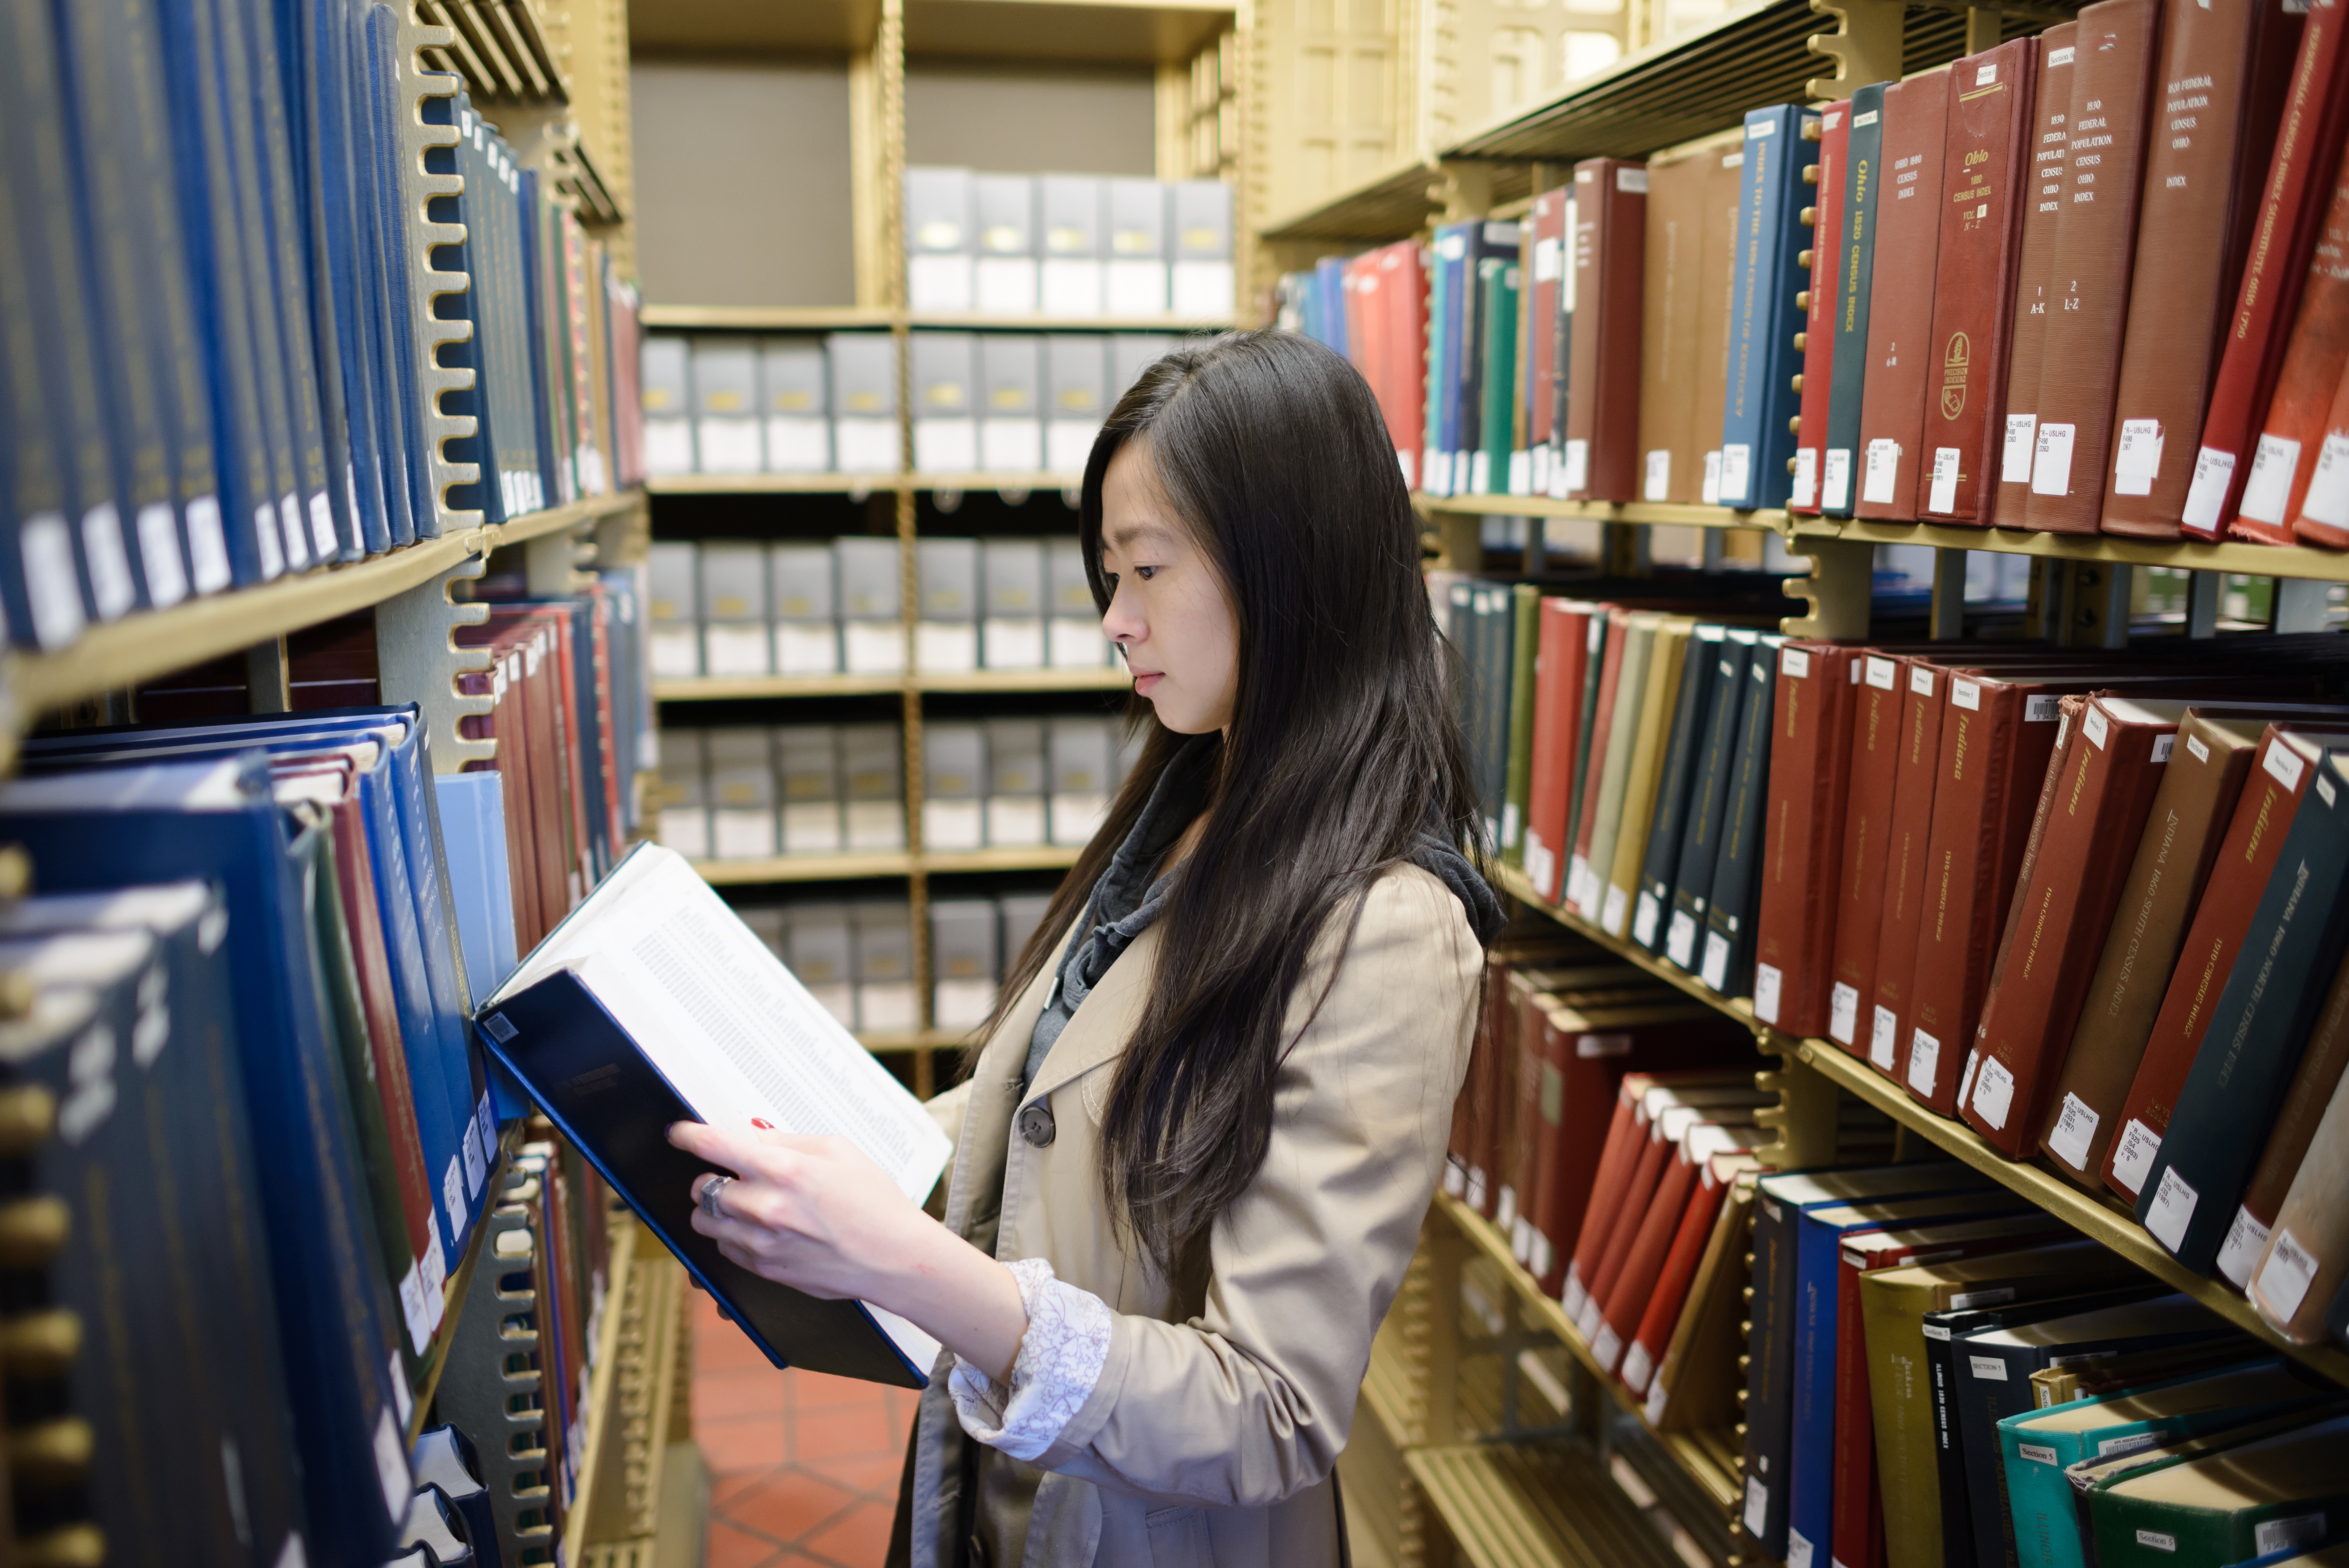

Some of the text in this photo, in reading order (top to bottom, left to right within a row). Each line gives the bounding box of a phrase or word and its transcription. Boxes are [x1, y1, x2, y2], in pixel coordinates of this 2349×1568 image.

[2050, 54, 2068, 64] Section
[2168, 75, 2212, 94] 1820 FEDERAL
[2087, 100, 2100, 111] 1830
[2167, 96, 2208, 112] POPULATION
[2051, 114, 2064, 124] 1830
[2078, 117, 2106, 131] FEDERAL
[2171, 117, 2196, 130] CENSUS
[2071, 135, 2111, 150] POPULATION
[2172, 137, 2190, 149] OHIO
[1894, 157, 1908, 170] OHIO
[1965, 149, 1988, 166] Ohio
[2076, 155, 2100, 166] CENSUS
[1897, 170, 1917, 184] CENSUS
[1971, 174, 1983, 185] 1880
[2078, 174, 2094, 184] OHIO
[2166, 176, 2186, 187] INDEX
[1898, 186, 1914, 200] INDEX
[1953, 186, 1991, 202] CENSUS INDEX
[2043, 184, 2058, 194] OHIO
[2074, 192, 2093, 202] INDEX
[2040, 202, 2058, 212] INDEX
[2237, 110, 2300, 339] CENSUS INDEX SUBSTITUTE OHIO 1790
[1846, 159, 1868, 332] Ohio 1820 CENSUS INDEX
[2038, 287, 2041, 296] 1
[2071, 281, 2076, 291] 2
[2031, 303, 2045, 314] A-K
[2064, 298, 2079, 309] L-Z
[1891, 342, 1895, 352] 2
[1944, 368, 1967, 376] PRECISION
[1944, 375, 1966, 384] INDEXING
[1912, 700, 1924, 764] Indiana
[1954, 713, 1969, 780] Indiana
[2188, 739, 2203, 756] Section
[2044, 754, 2058, 792] INDIANA
[2069, 745, 2092, 816] Indiana
[2246, 784, 2277, 863] Indiana
[2021, 852, 2035, 881] INDEX
[2283, 867, 2309, 921] INDIANA
[2108, 814, 2178, 1018] INDIANA 1860 SOUTH CENSUS INDEX
[2023, 887, 2052, 980] 1910 CENSUS INDEX
[2251, 956, 2273, 1004] NORTH
[2183, 938, 2223, 1038] 1910 CENSUS INDEX
[2232, 1003, 2255, 1051] CENSUS
[2066, 1105, 2076, 1116] F525
[2062, 1117, 2074, 1132] (1987)
[2129, 1132, 2140, 1144] F525
[2123, 1144, 2138, 1160] (2003)
[2162, 1177, 2171, 1191] F525
[2157, 1191, 2169, 1208] (1987)
[2235, 1218, 2244, 1232] F525
[2022, 1448, 2046, 1459] Section
[2038, 1512, 2052, 1565] ILLINOIS
[2139, 1532, 2166, 1545] Section
